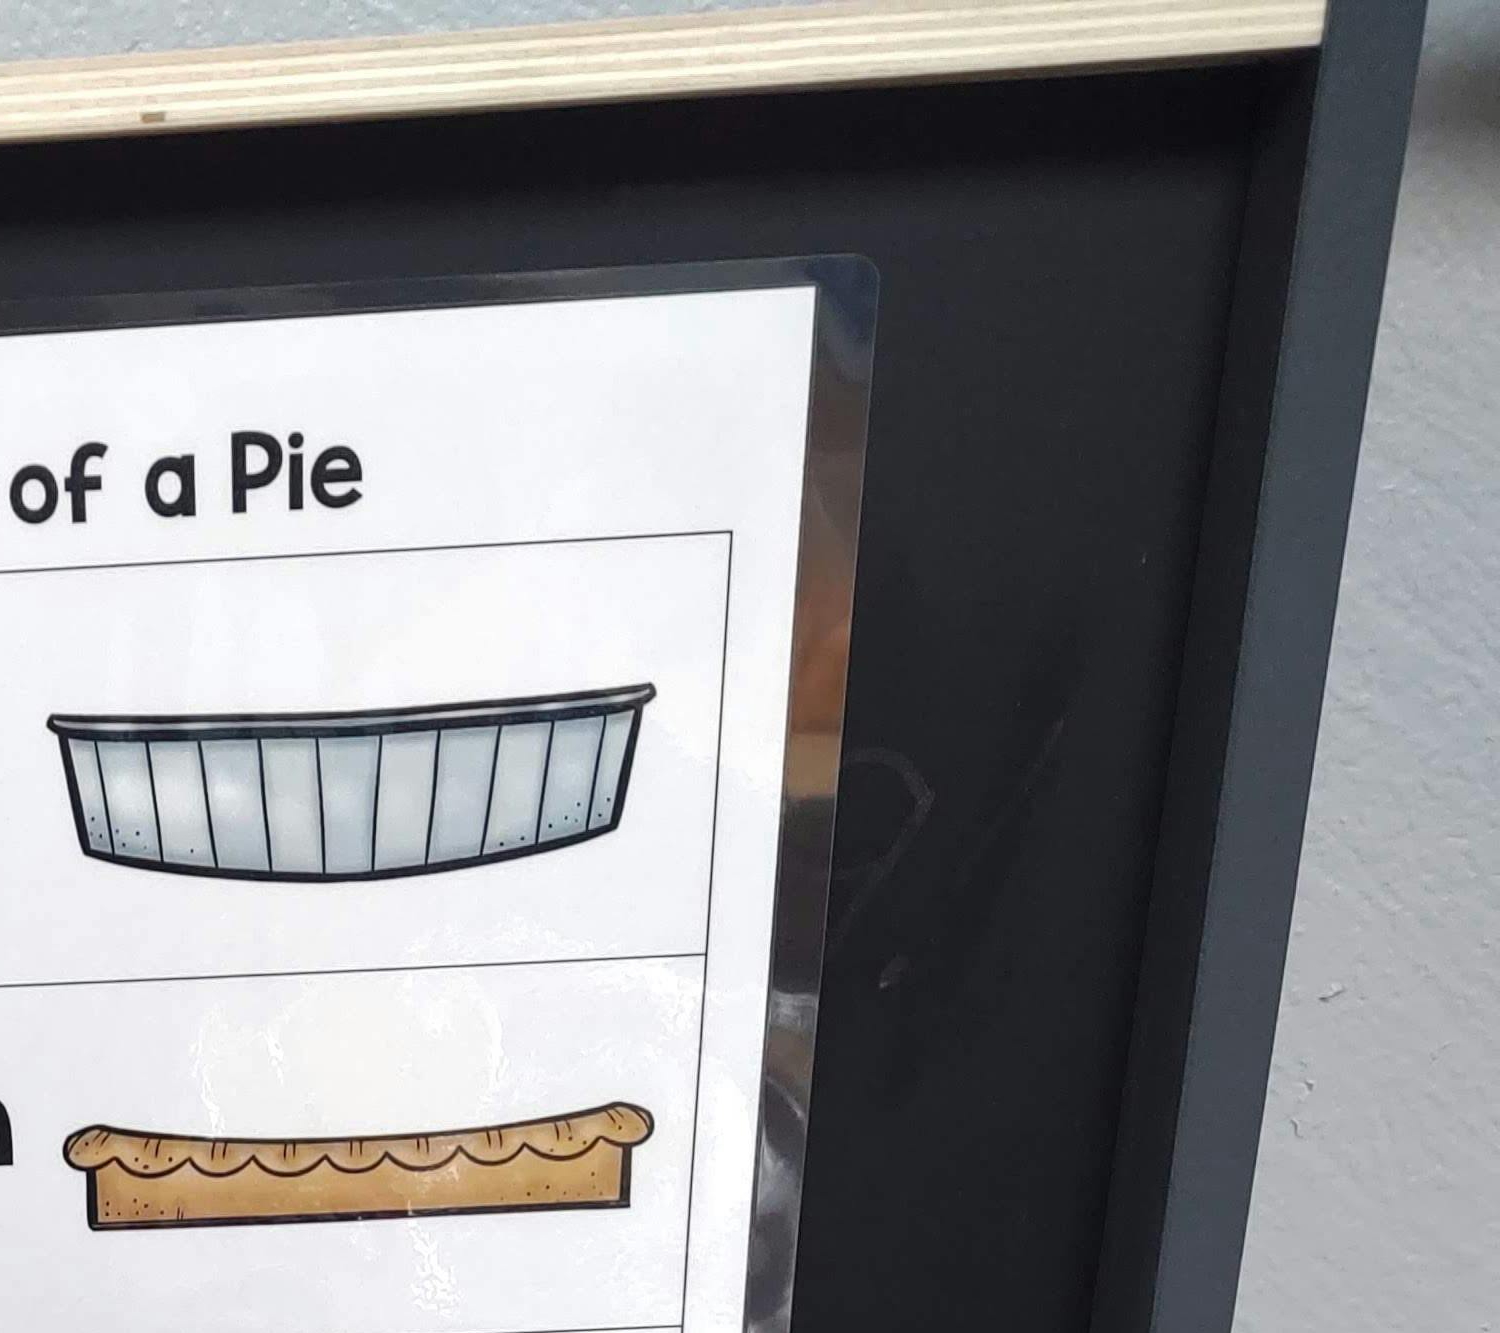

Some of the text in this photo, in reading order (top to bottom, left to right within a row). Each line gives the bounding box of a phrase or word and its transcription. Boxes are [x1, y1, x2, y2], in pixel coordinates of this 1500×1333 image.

[9, 442, 107, 524] of
[145, 455, 196, 518] a
[231, 431, 363, 513] Pie
